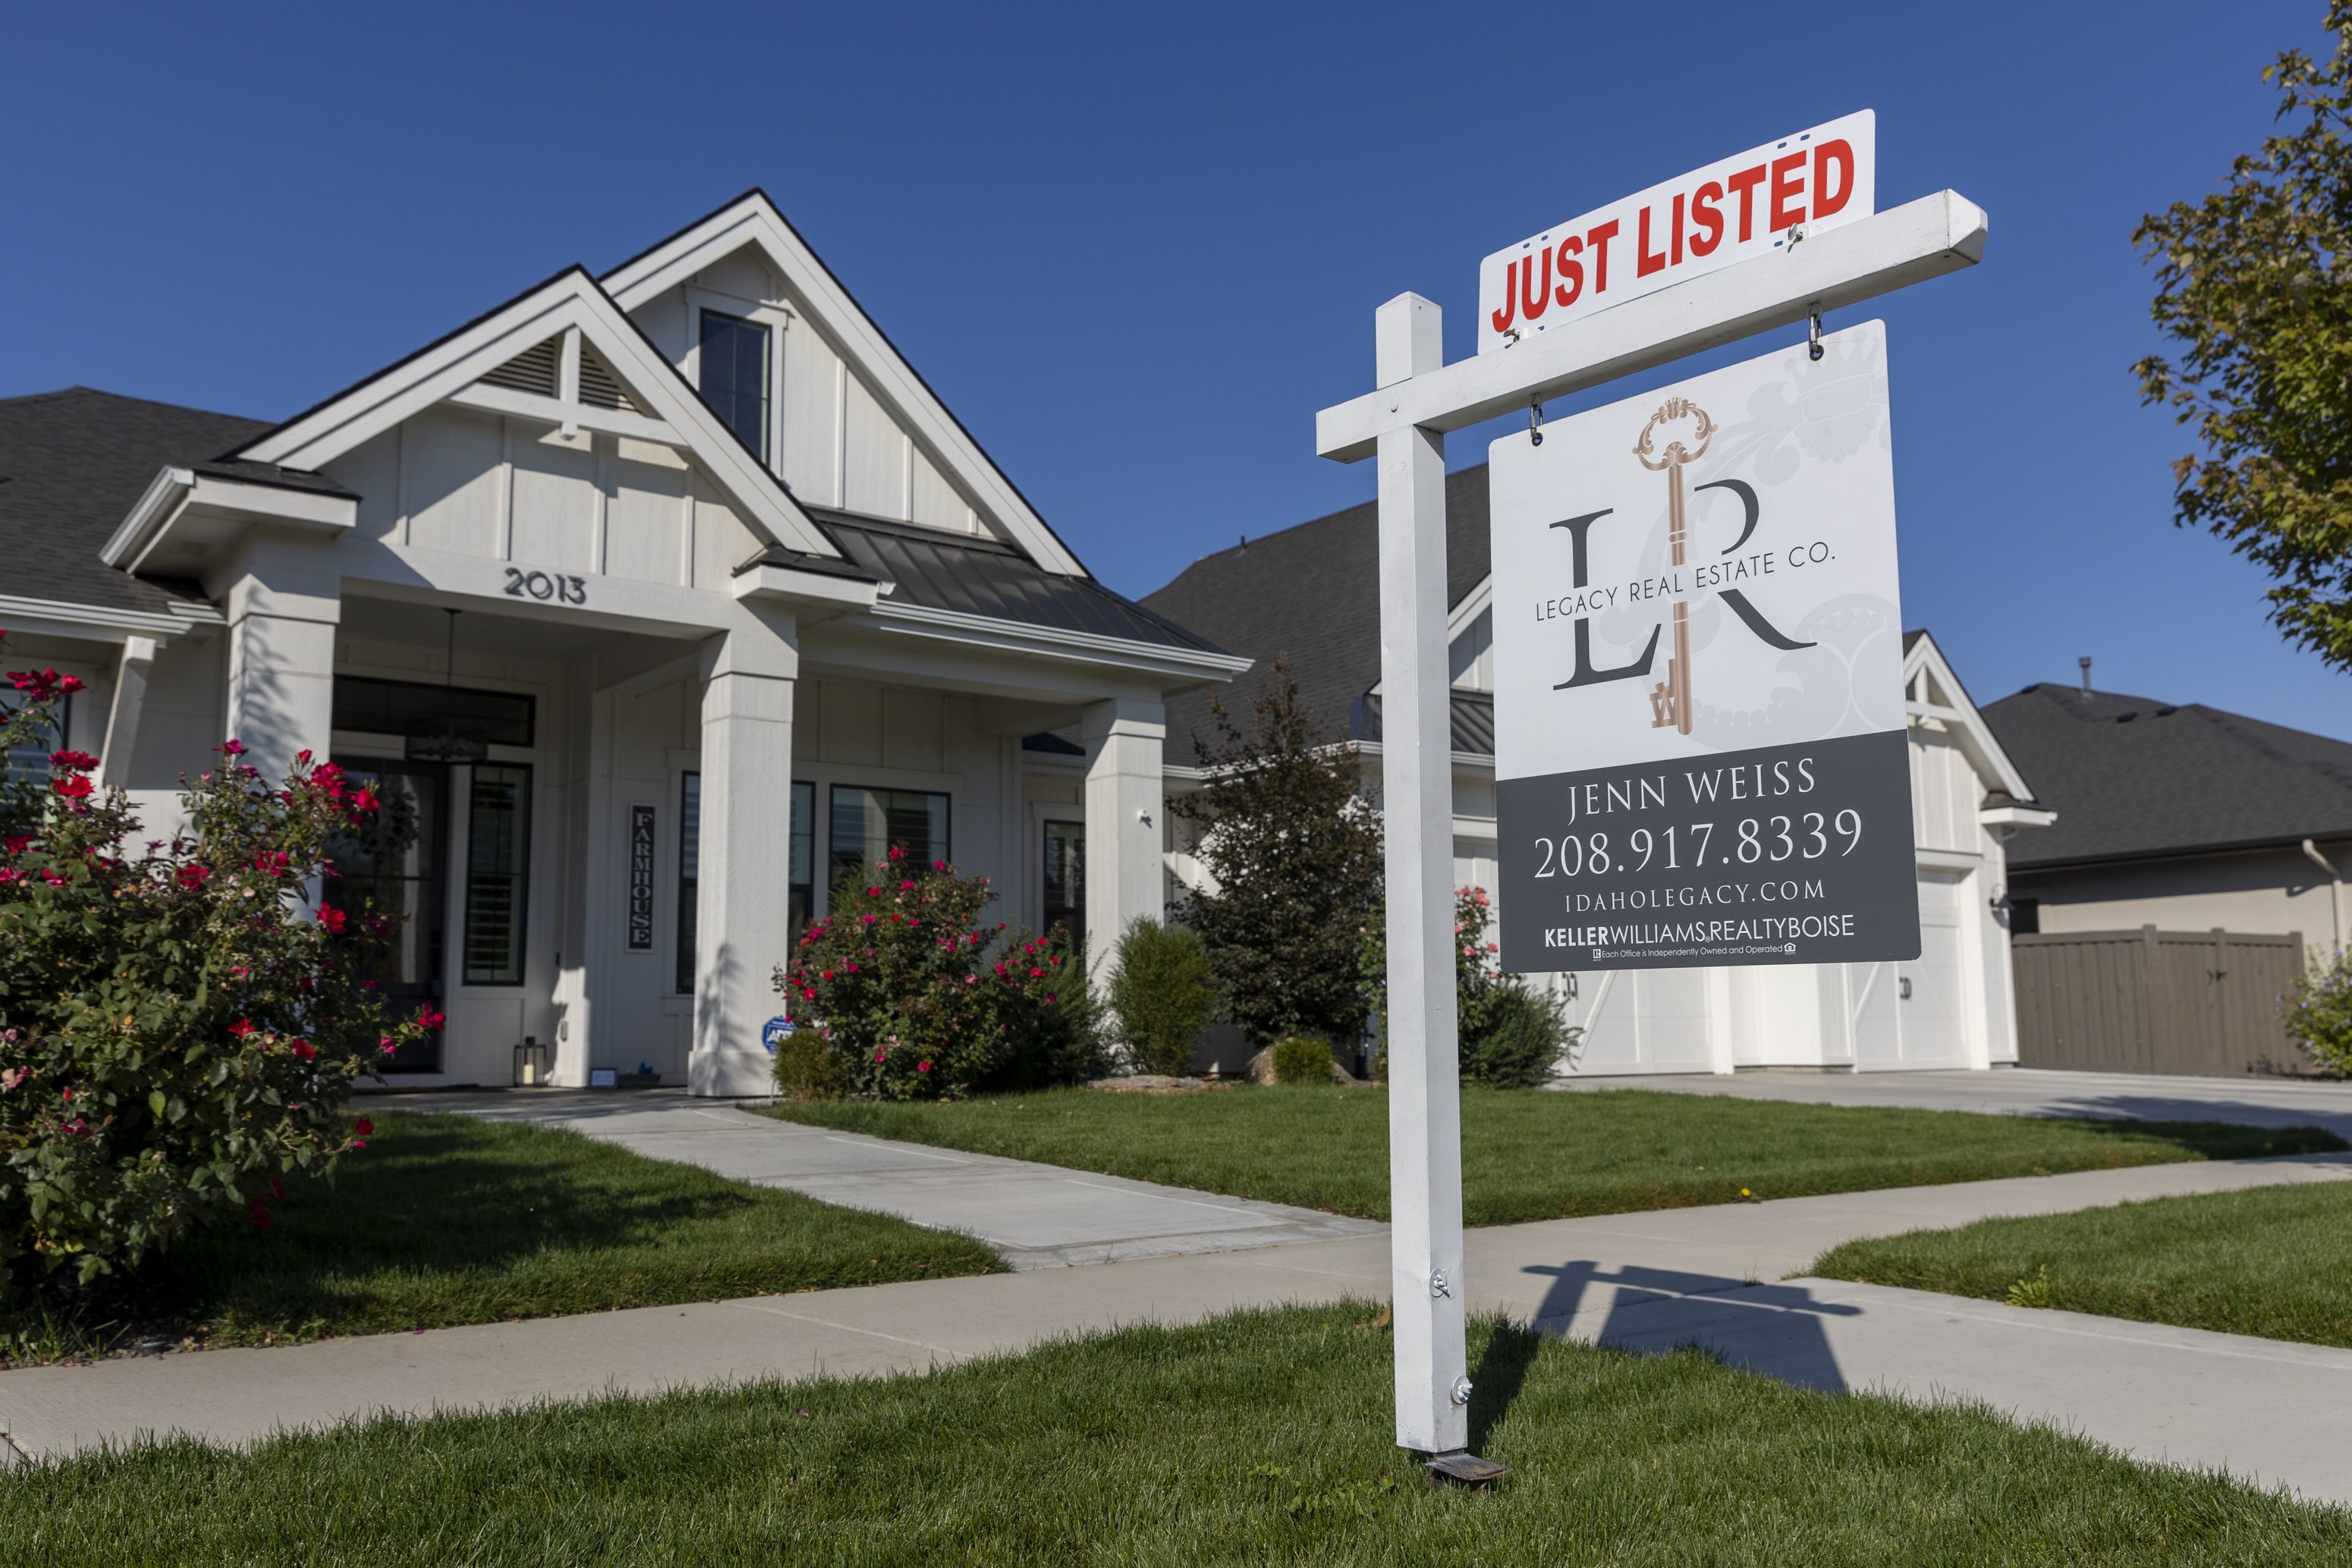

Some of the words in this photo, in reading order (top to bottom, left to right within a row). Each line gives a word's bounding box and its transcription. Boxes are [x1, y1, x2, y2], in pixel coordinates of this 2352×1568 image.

[1492, 218, 1619, 332] JUST
[1637, 139, 1854, 278] LISTED
[503, 567, 586, 605] 2013
[1536, 586, 1618, 621] LEGACY
[1630, 573, 1684, 602] REAL
[1696, 552, 1775, 589] ESTATE
[1788, 541, 1835, 567] CO.
[1567, 775, 1666, 826] JENN
[1684, 758, 1816, 804] WEISS
[1534, 809, 1862, 878] 208.917.8339
[631, 812, 653, 944] FARMHOUSE
[1565, 879, 1825, 913] IDAHOLEGACY.COM
[1602, 950, 1619, 958] Each
[1620, 949, 1641, 957] Office
[1648, 947, 1699, 958] Independently
[1700, 946, 1728, 955] Owned
[1728, 946, 1744, 954] and
[1745, 944, 1783, 954] Operated
